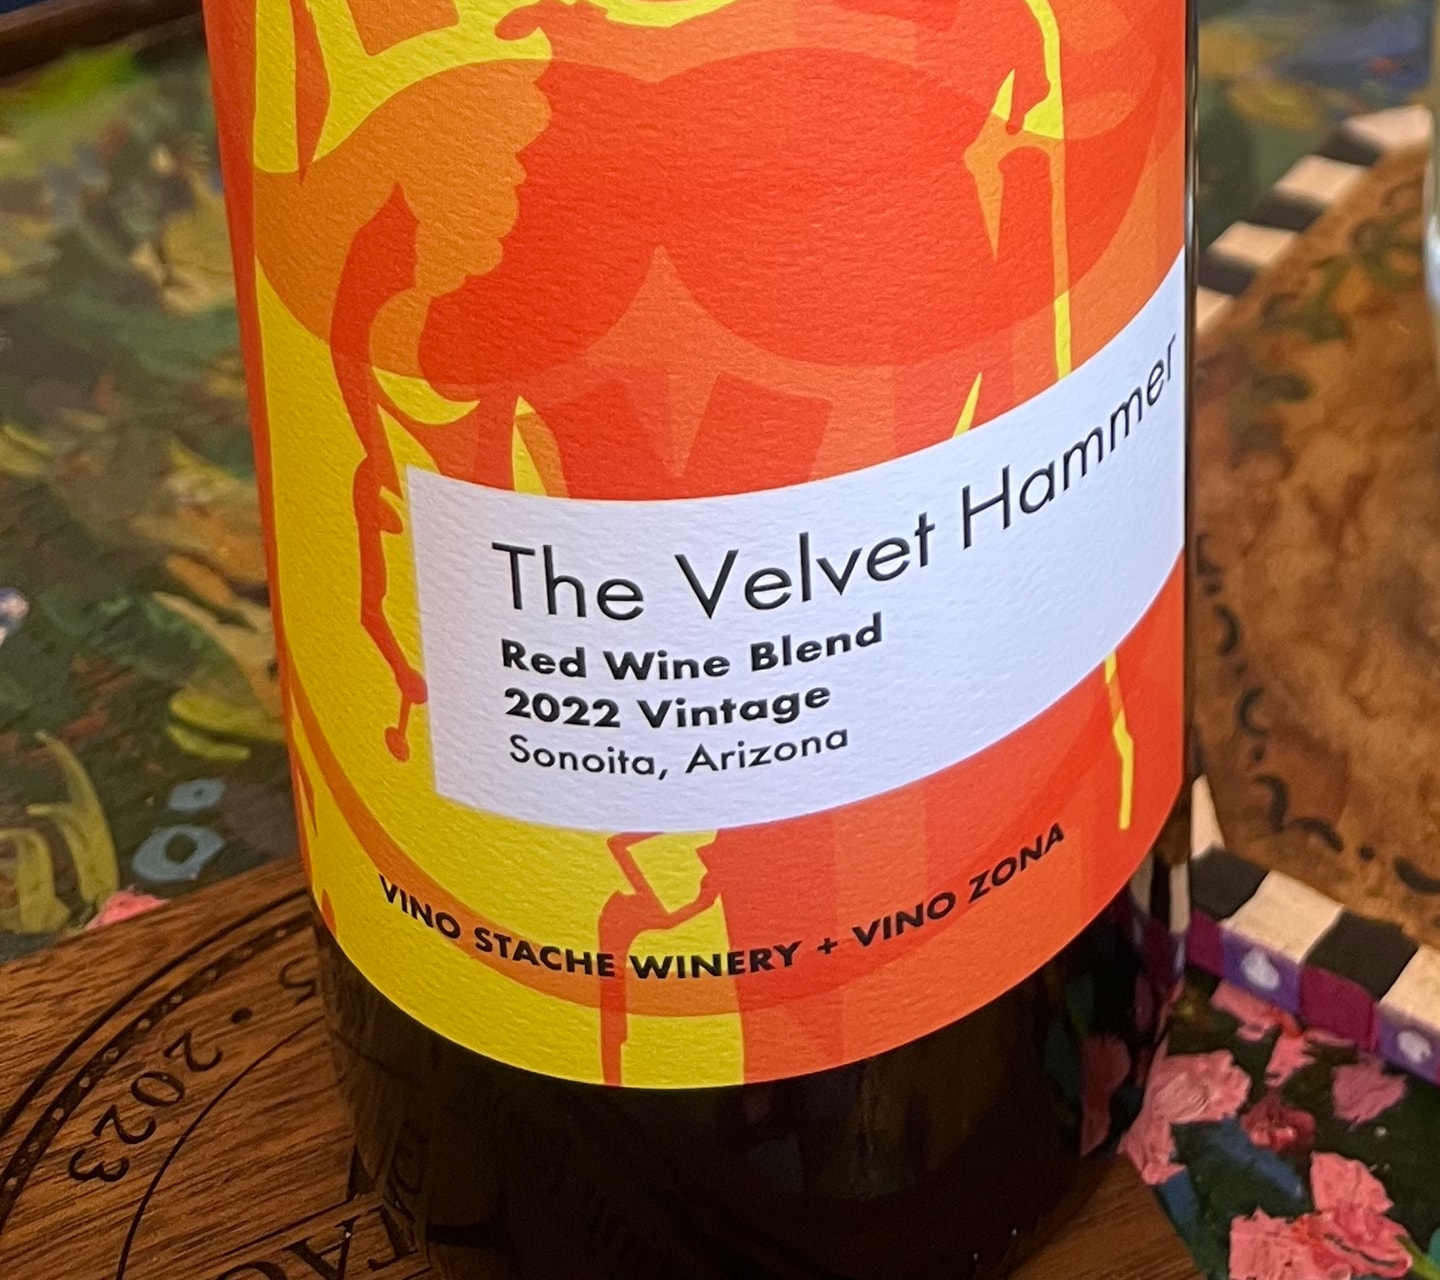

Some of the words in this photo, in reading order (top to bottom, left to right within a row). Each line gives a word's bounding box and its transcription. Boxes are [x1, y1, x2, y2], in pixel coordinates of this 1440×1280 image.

[491, 541, 645, 621] The
[674, 511, 936, 620] Velvet
[961, 332, 1176, 550] Hammer
[501, 638, 587, 678] Red
[602, 649, 731, 681] Wine
[750, 611, 882, 672] Blend
[504, 687, 621, 728] 2022
[636, 686, 831, 729] Vintage
[509, 734, 669, 781] Sonoita,
[684, 728, 849, 774] Arizona
[378, 873, 462, 940] VINO
[473, 926, 616, 978] STACHE
[629, 940, 803, 980] WINERY
[816, 937, 839, 955] +
[851, 891, 957, 948] VINO
[967, 822, 1065, 904] ZONA
[67, 1030, 223, 1183] 2023
